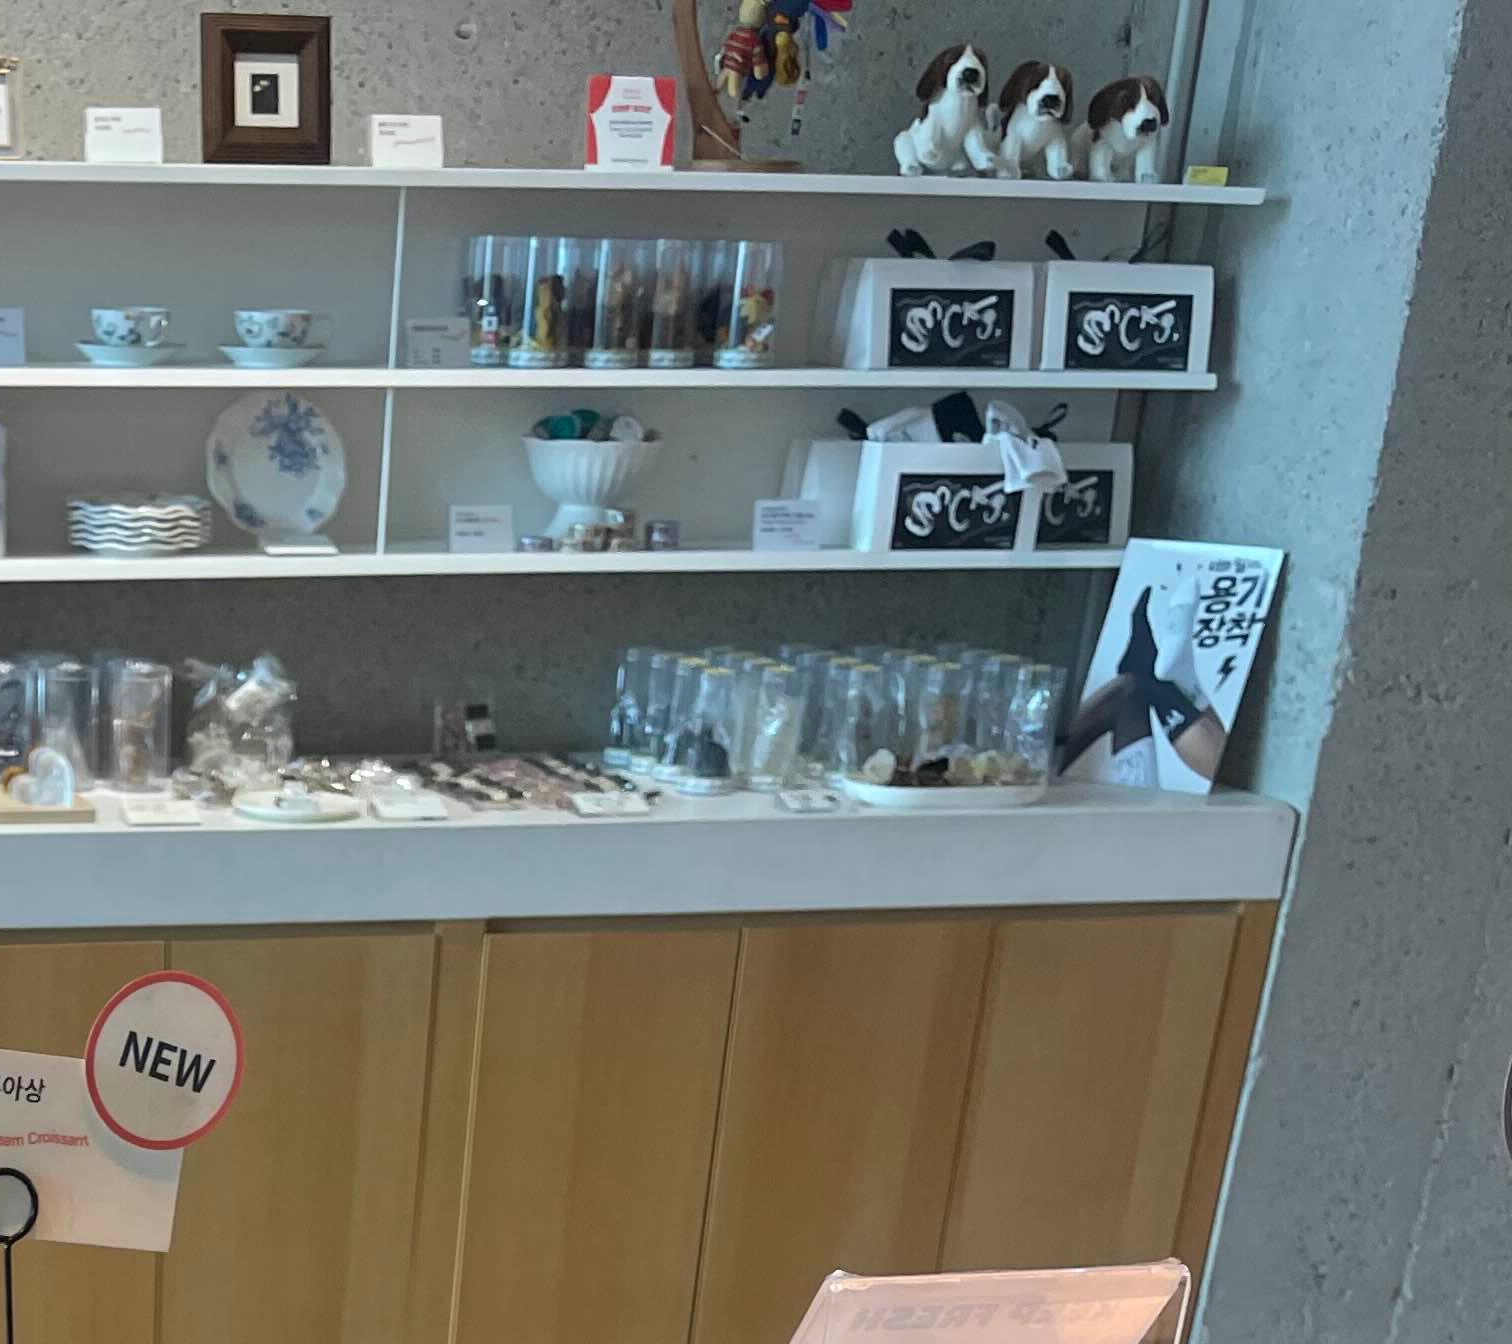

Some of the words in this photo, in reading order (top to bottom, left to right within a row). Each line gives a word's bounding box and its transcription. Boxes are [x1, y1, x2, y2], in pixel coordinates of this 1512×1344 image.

[1200, 569, 1269, 613] 용기
[1192, 613, 1267, 648] 장착
[118, 1031, 217, 1093] NEW
[28, 1131, 88, 1146] Croissant
